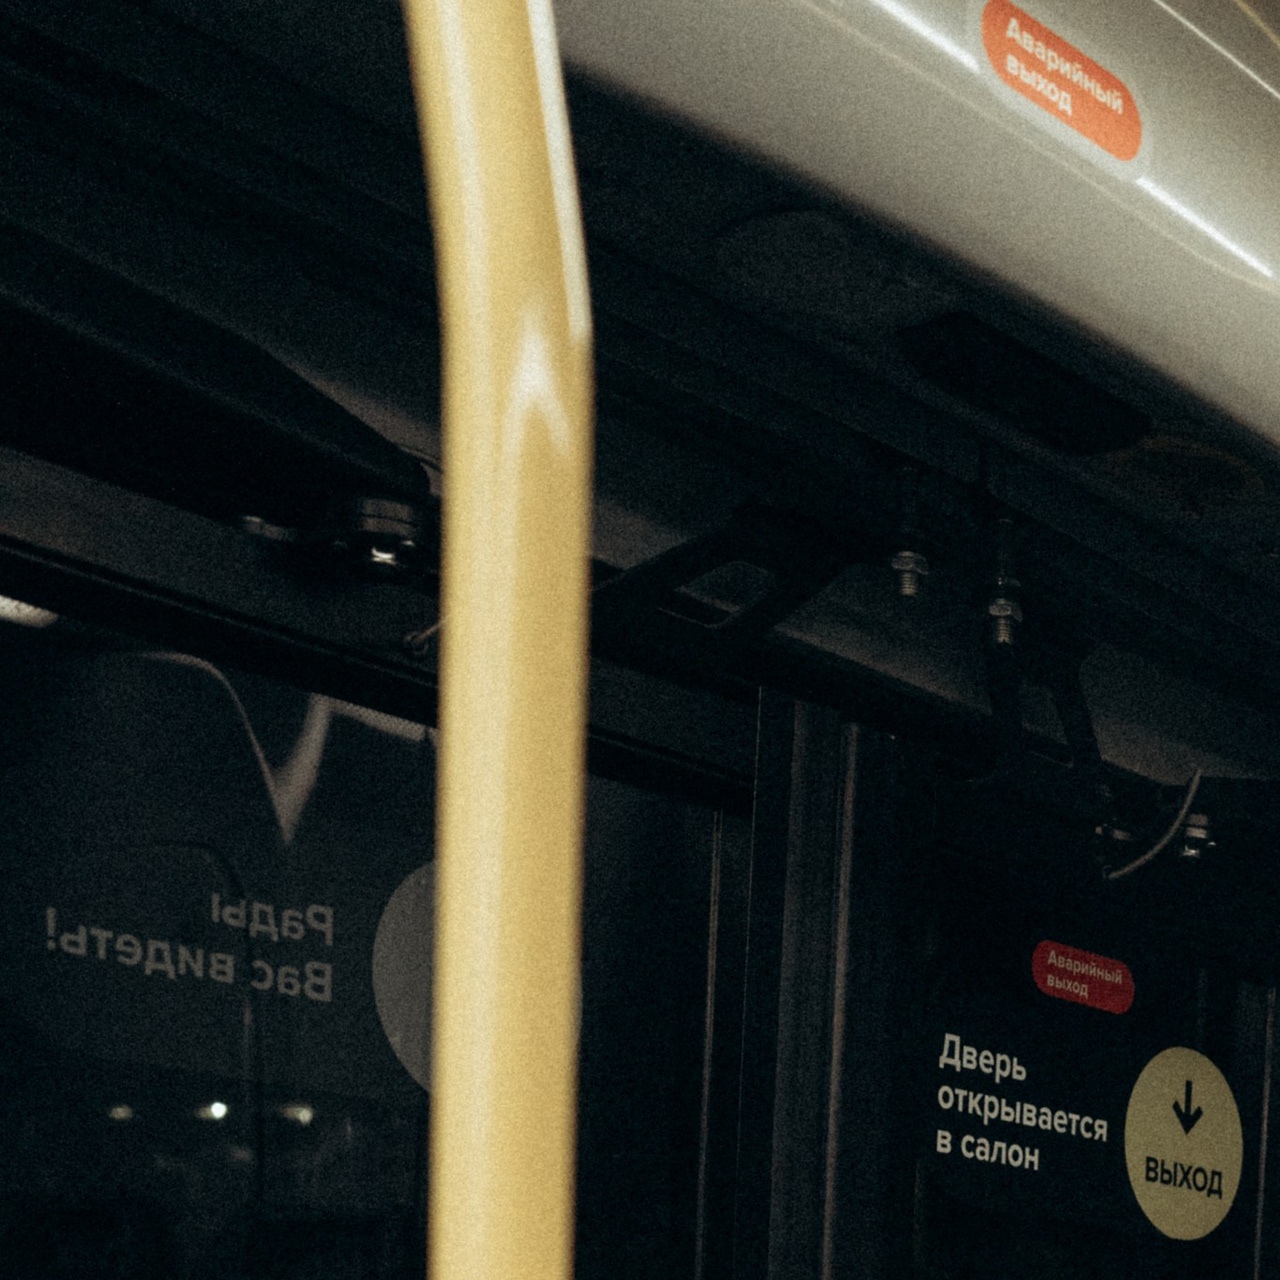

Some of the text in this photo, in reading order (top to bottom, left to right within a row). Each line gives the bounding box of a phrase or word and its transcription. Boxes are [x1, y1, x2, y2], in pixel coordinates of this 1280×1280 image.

[1006, 17, 1123, 114] Аварийный
[1006, 54, 1072, 116] выход
[1046, 974, 1089, 999] выход
[1047, 949, 1123, 985] Аварийный
[938, 1032, 1028, 1084] Дверь
[937, 1084, 1109, 1143] открывается
[935, 1129, 1041, 1172] в салон
[1144, 1155, 1224, 1200] ВЫХОД
